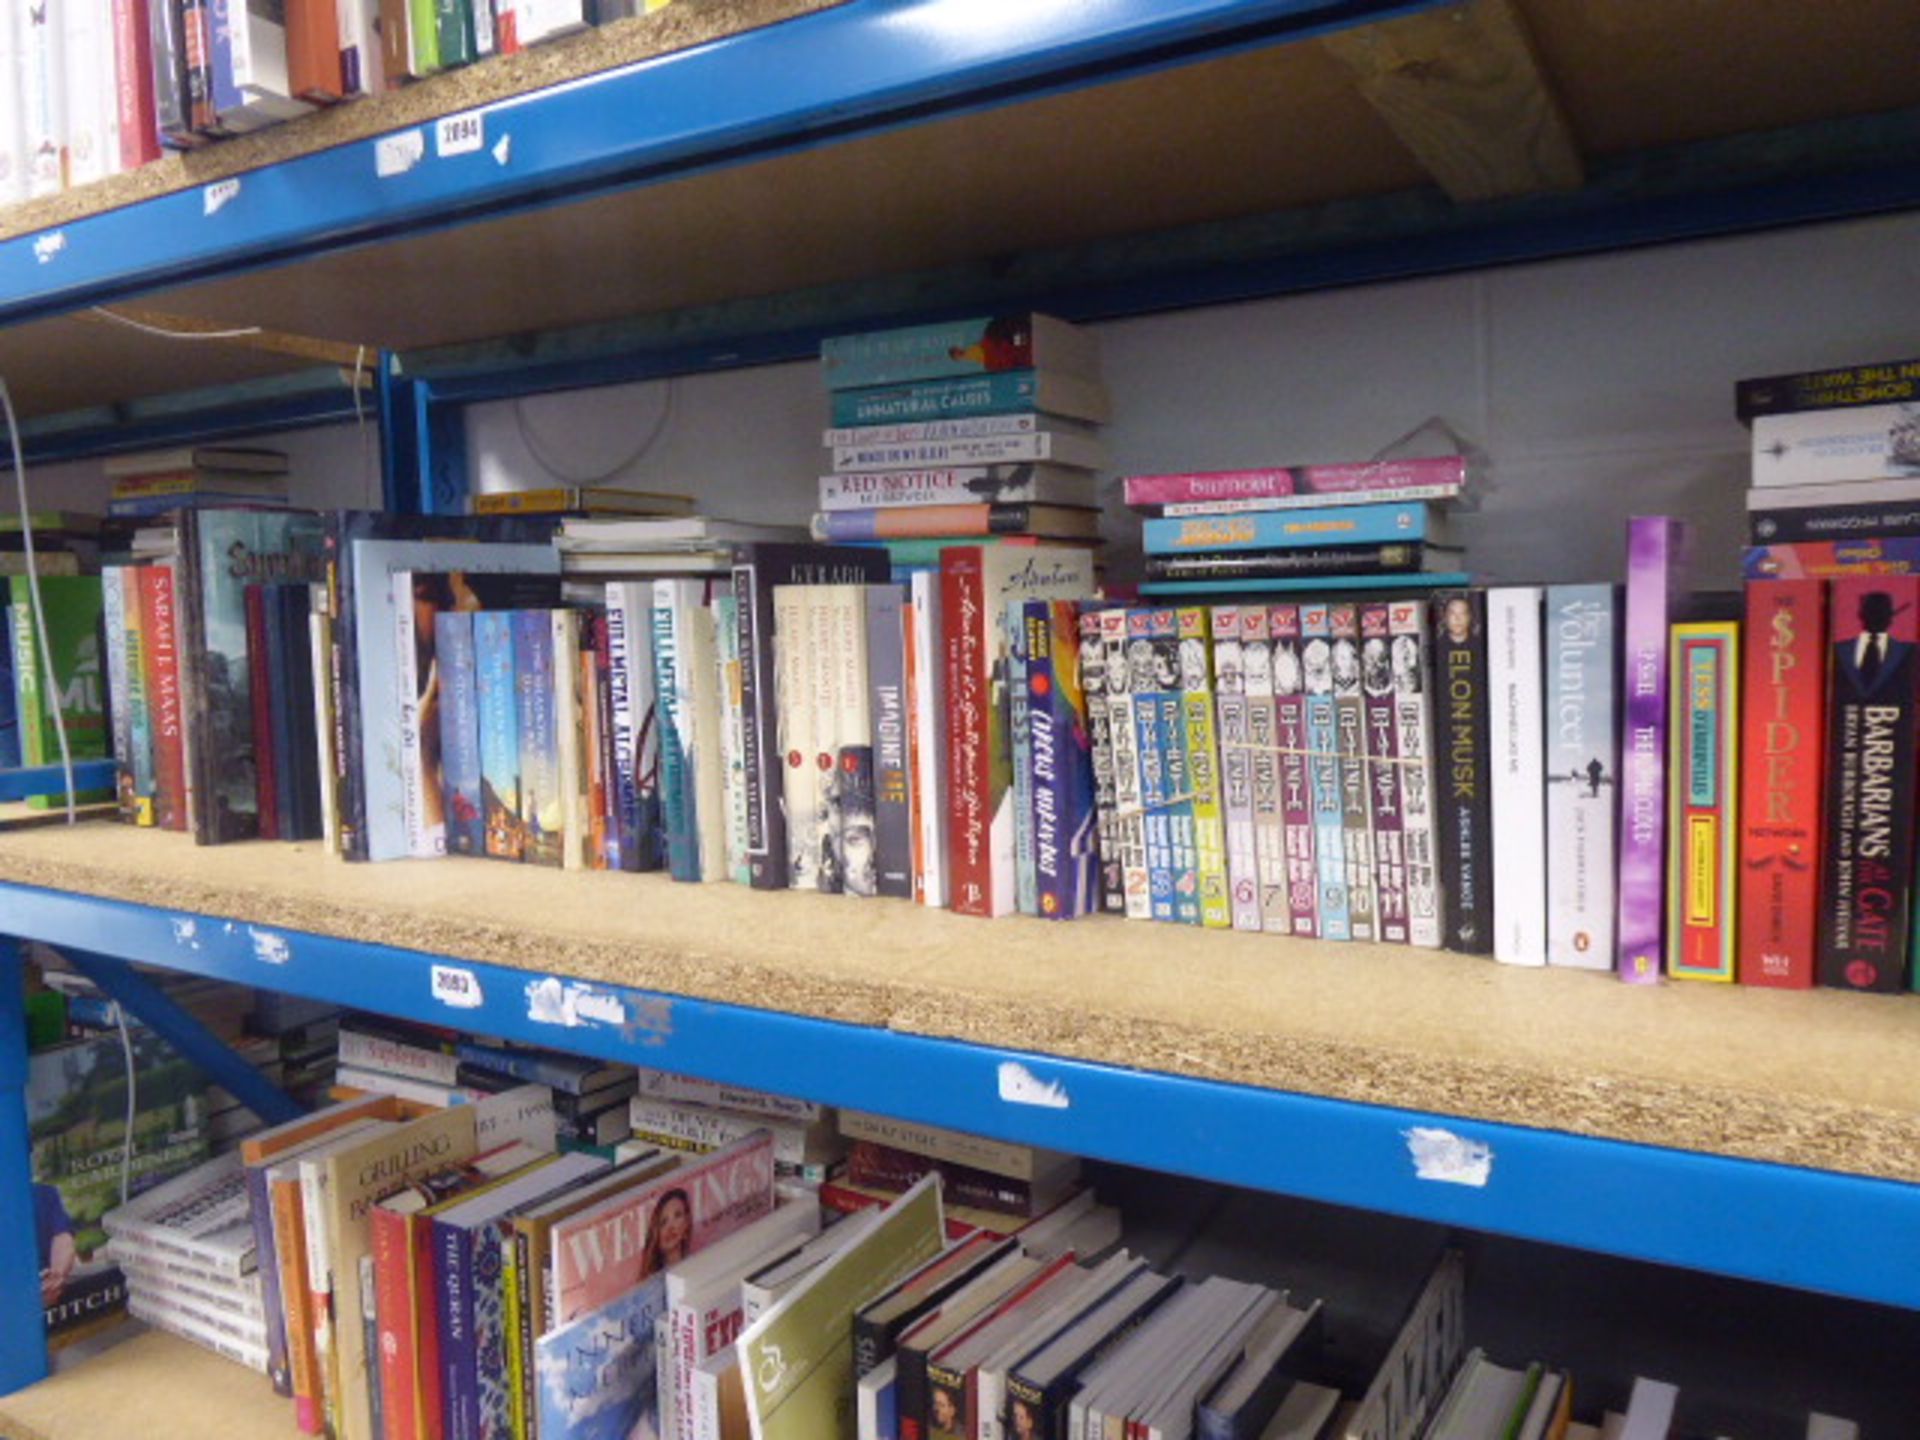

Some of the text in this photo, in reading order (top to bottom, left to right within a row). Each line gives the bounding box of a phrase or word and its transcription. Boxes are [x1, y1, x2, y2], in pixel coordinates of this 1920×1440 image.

[880, 469, 957, 492] NOTICE
[13, 601, 36, 695] MUSIC
[152, 577, 174, 650] SARAH
[158, 674, 179, 738] MAAS
[878, 685, 902, 769] IMAGINE
[1011, 676, 1032, 746] LESS
[1448, 649, 1475, 798] ELON MUSK
[1858, 703, 1901, 858] BARBARIANS
[1855, 886, 1893, 952] GATE
[446, 1232, 460, 1273] THE
